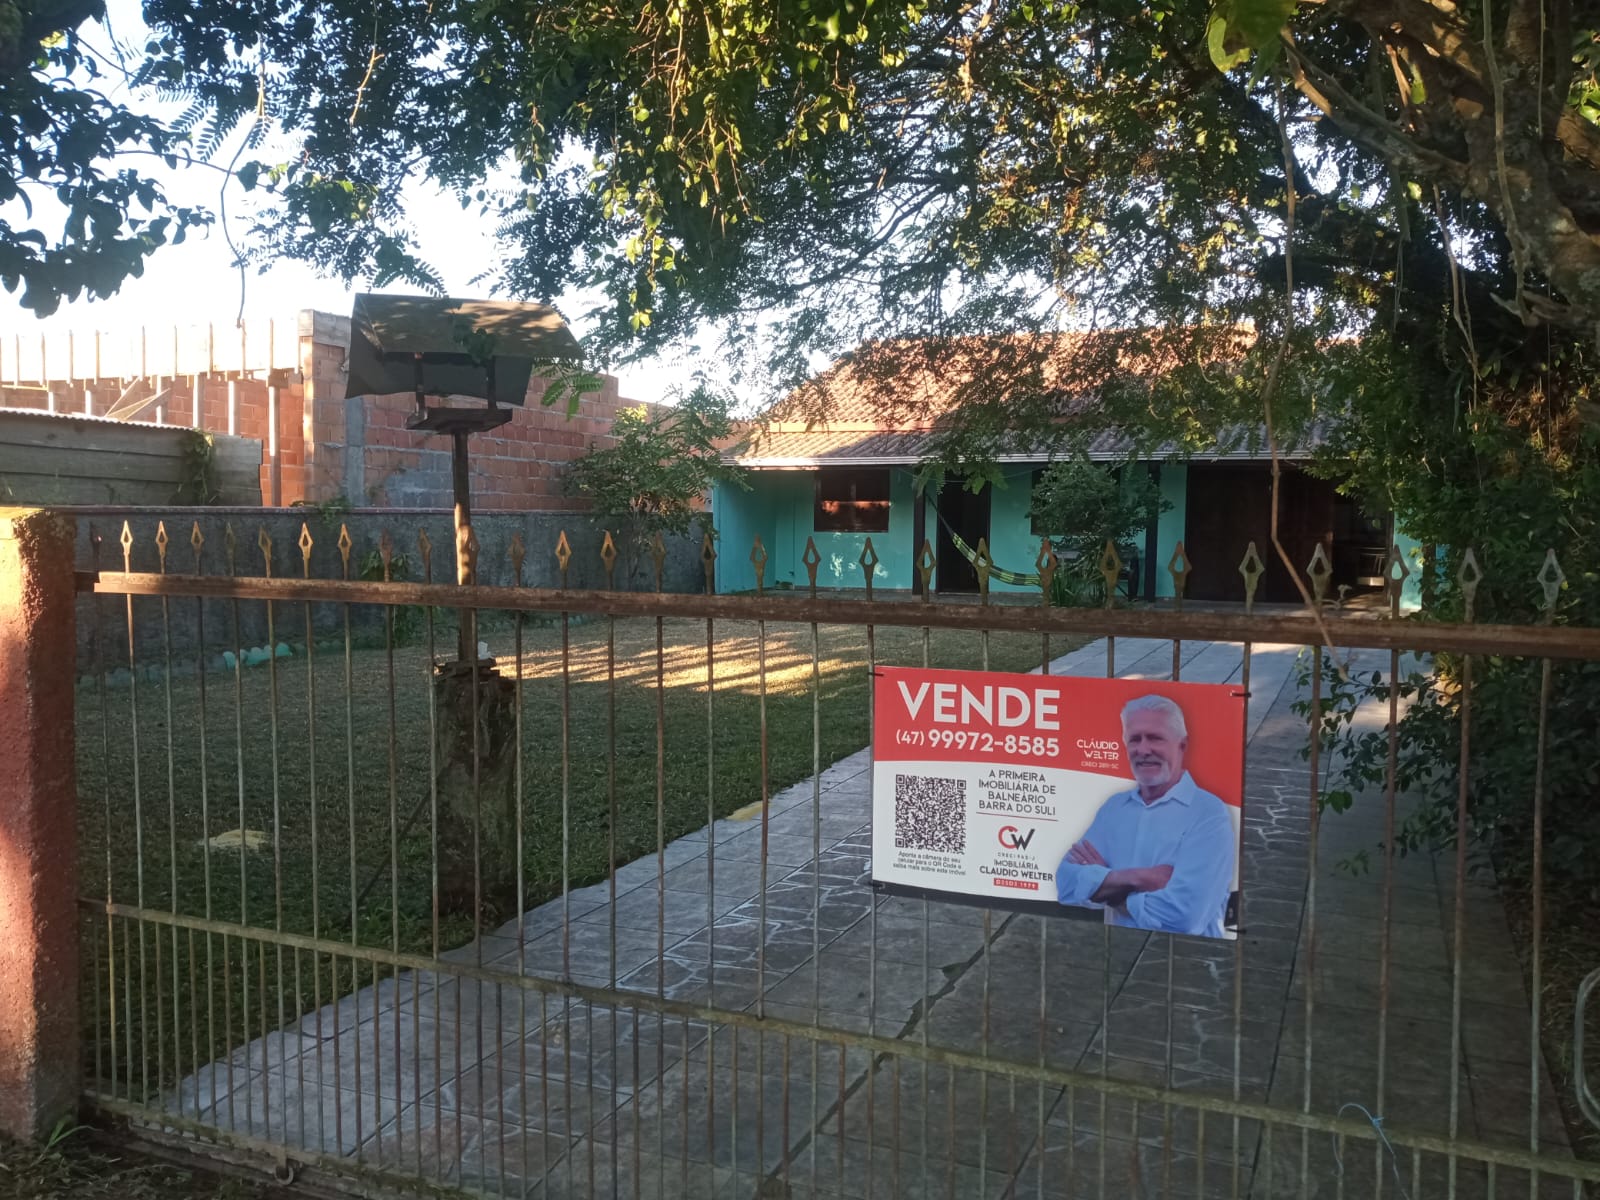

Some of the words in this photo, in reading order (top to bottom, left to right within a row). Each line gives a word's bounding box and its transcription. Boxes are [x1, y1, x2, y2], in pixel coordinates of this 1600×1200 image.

[897, 681, 1060, 731] VENDE
[895, 729, 925, 746] (47)
[928, 728, 1060, 758] 99972-8585
[1076, 738, 1120, 751] CLÁUDIO
[1083, 750, 1120, 761] WELTER
[988, 769, 996, 778] A
[998, 769, 1046, 782] PRIMEIRA
[978, 778, 1039, 793] IMOBILIÁRIA
[1042, 784, 1057, 795] DE
[988, 790, 1047, 804] BALNEÁRIO
[978, 799, 1014, 812] BARRA
[1016, 803, 1033, 814] DO
[994, 858, 1040, 871] IMOBILIÁRIA
[979, 865, 1019, 878] CLAUDIO
[1020, 870, 1054, 882] WELTER
